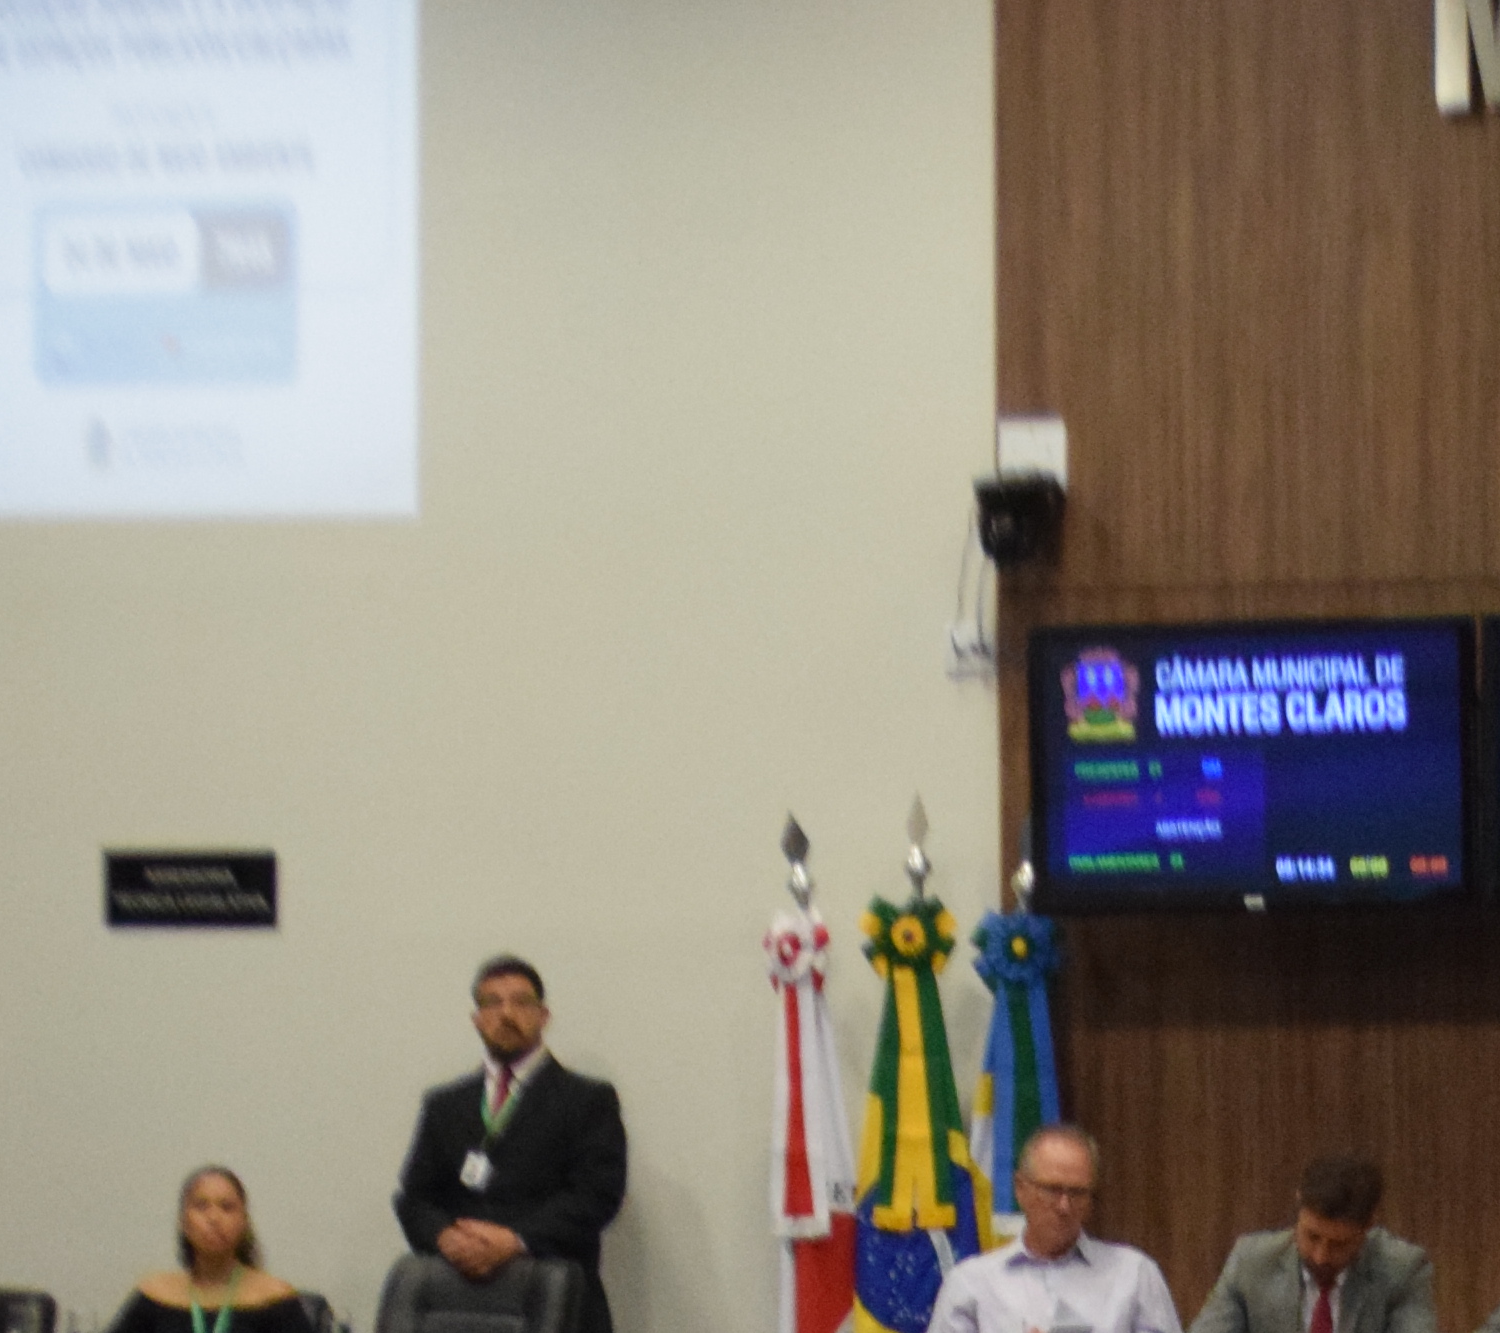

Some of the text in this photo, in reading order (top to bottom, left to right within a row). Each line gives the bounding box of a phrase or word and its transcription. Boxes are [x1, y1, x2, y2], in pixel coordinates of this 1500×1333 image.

[1252, 653, 1369, 690] MUNICIPAL
[1374, 652, 1405, 687] DE
[1155, 688, 1408, 738] MONTES CLAROS
